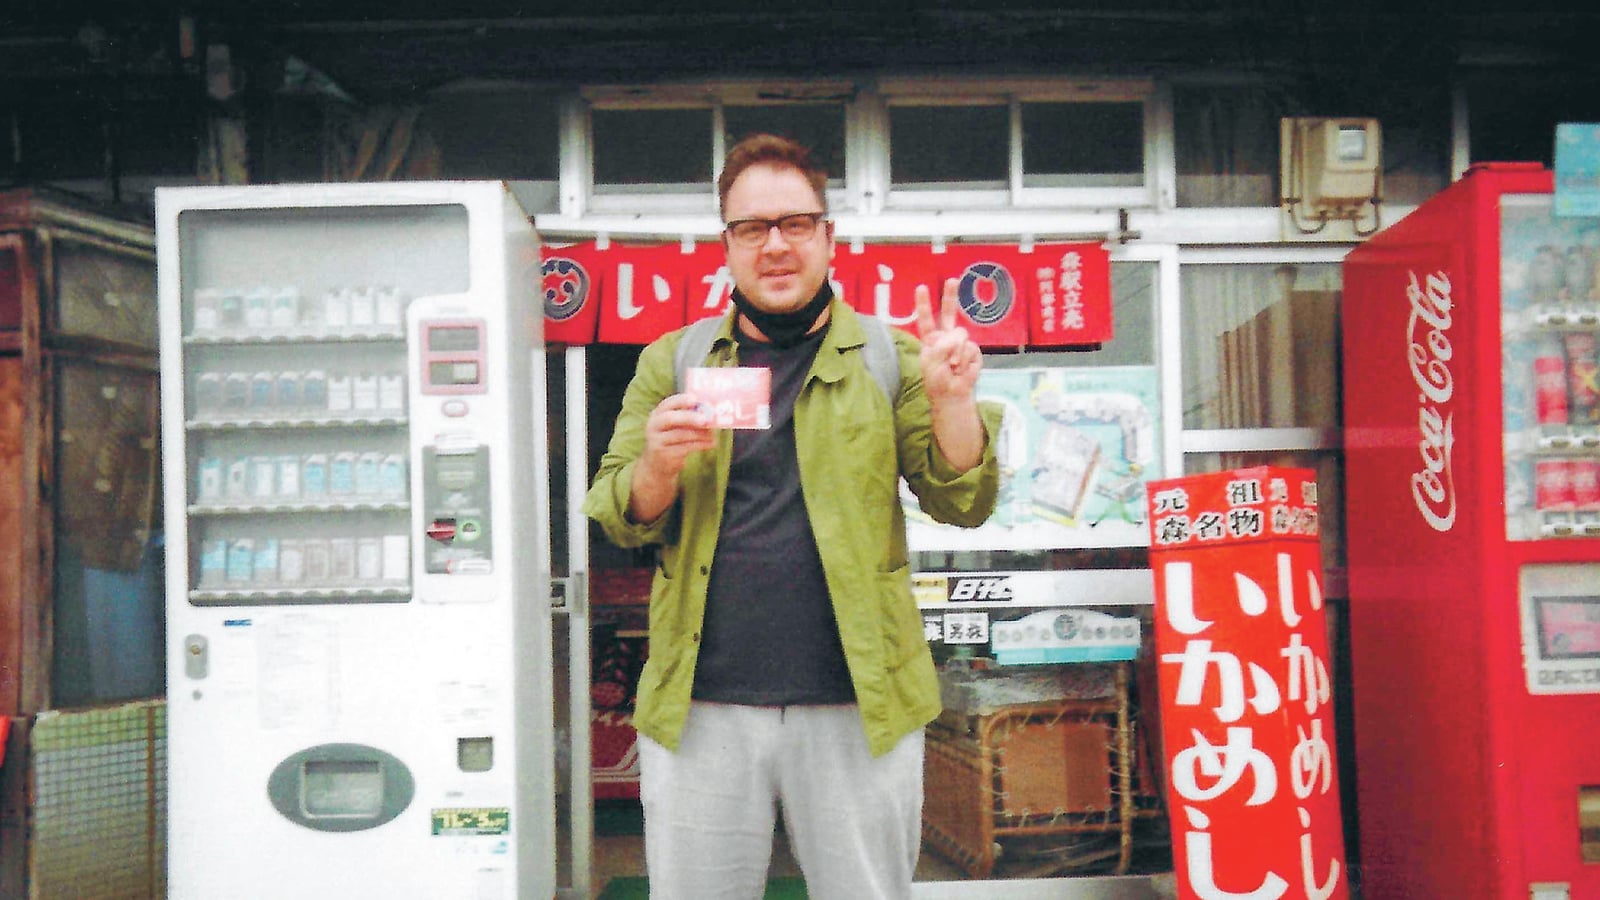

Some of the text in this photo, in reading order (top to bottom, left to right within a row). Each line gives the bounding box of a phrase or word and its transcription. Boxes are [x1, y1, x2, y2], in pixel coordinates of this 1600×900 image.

[1156, 508, 1264, 543] 森名物
[1161, 562, 1290, 900] いかめし
[1277, 552, 1340, 900] いかめし
